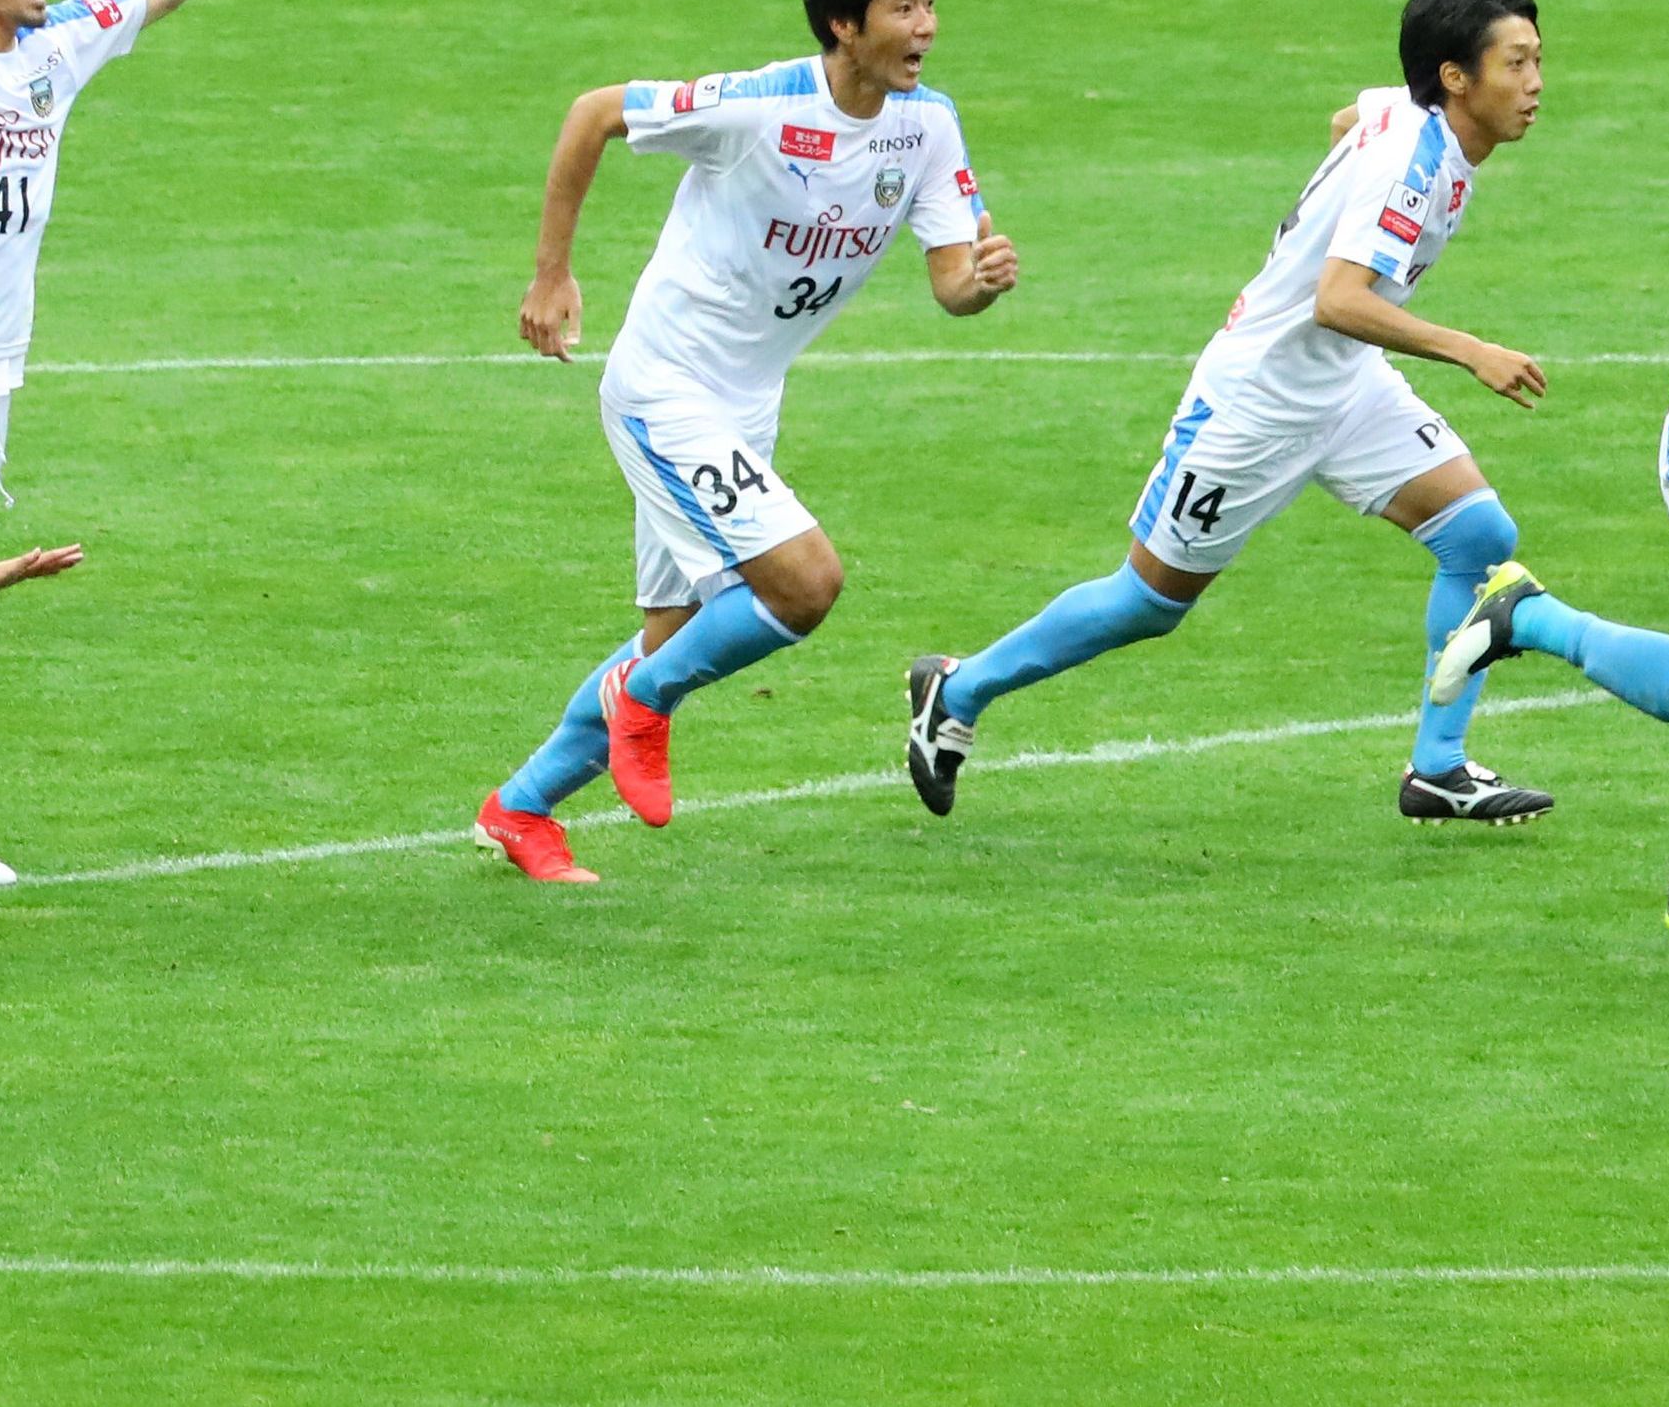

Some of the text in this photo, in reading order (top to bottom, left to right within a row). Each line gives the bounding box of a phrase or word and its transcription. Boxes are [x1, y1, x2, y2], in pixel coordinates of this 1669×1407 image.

[763, 216, 892, 269] FUJITSU
[774, 276, 843, 320] 34
[692, 449, 769, 516] 34
[1171, 471, 1227, 533] 14
